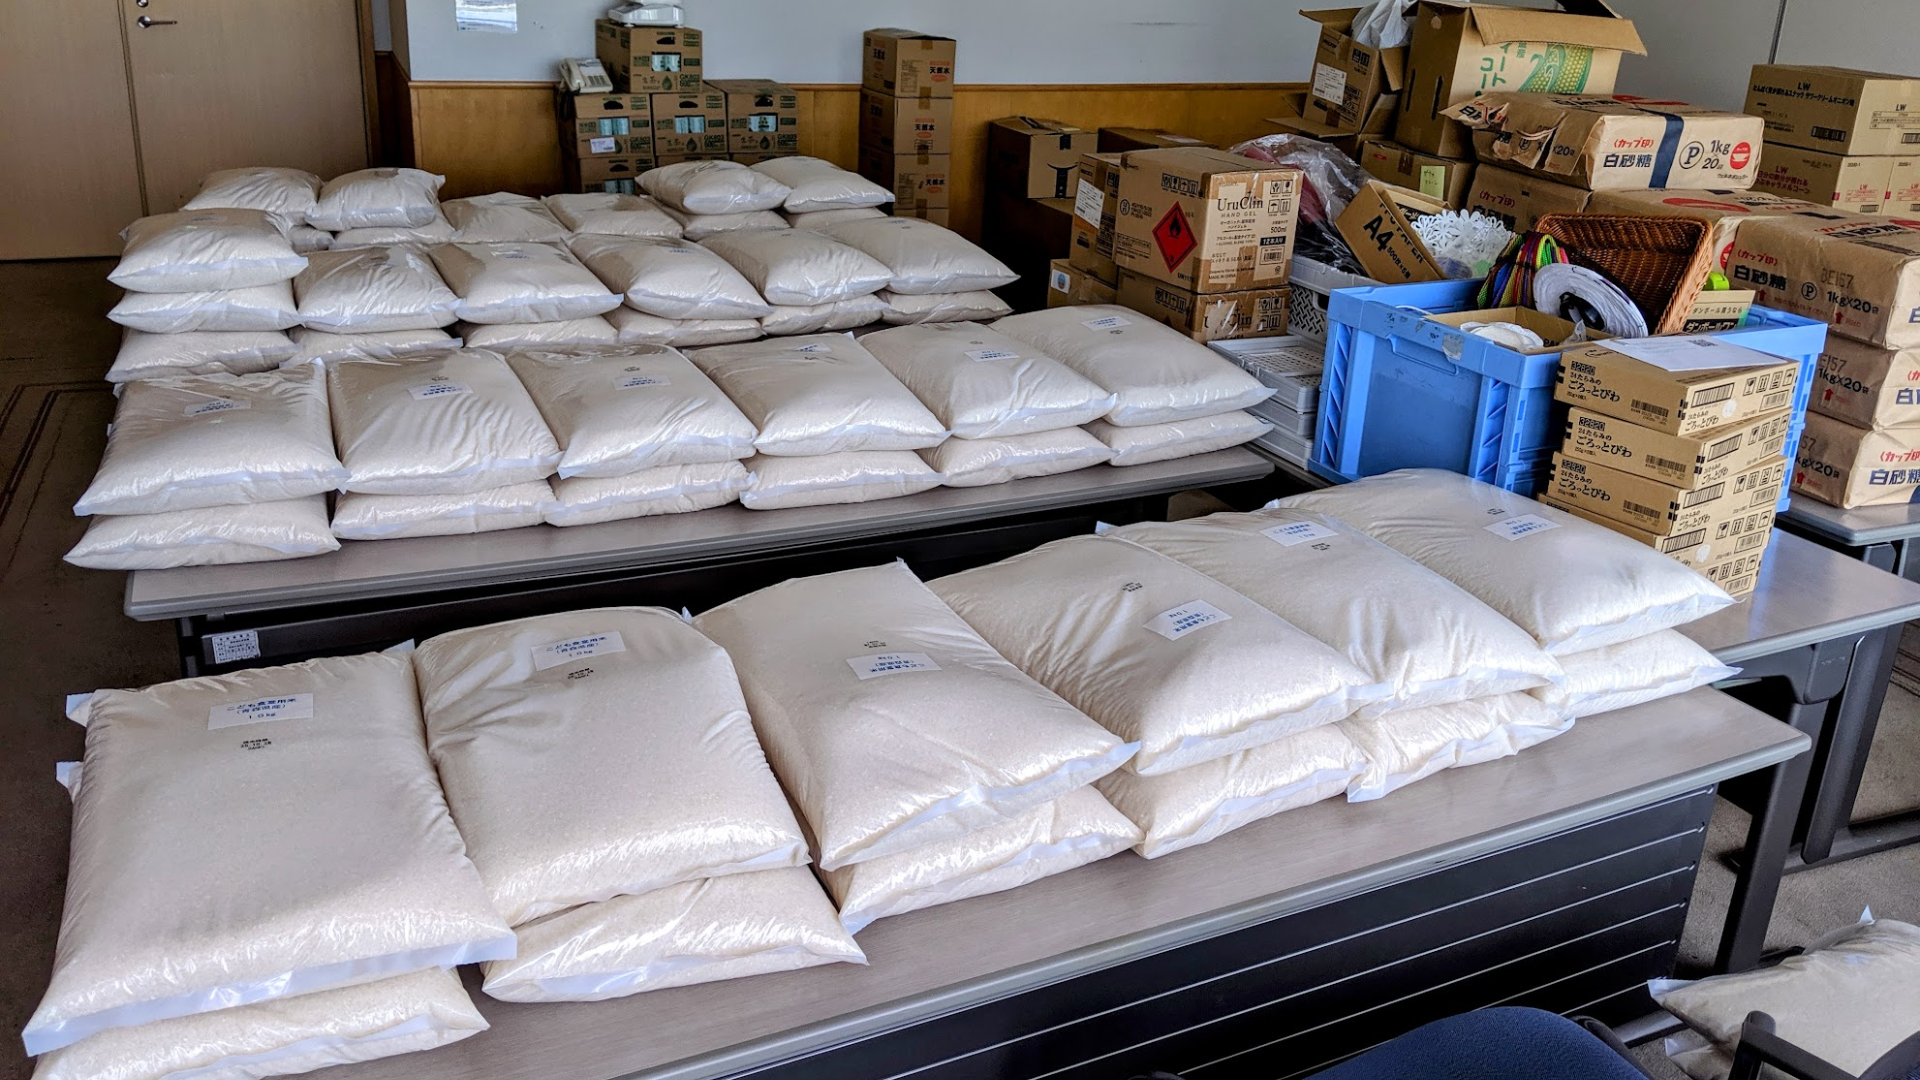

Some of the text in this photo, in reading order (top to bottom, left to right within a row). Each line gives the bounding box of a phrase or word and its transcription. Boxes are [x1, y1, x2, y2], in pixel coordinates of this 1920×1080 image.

[1797, 82, 1811, 91] LW
[1710, 139, 1731, 156] 1kg
[1603, 154, 1653, 168] 白砂糖
[1775, 166, 1788, 174] LW
[1217, 195, 1263, 212] UruClin
[1270, 226, 1287, 234] 500ml
[1363, 215, 1395, 252] A4
[1734, 265, 1787, 291] 白砂糖
[1567, 379, 1620, 402] ごろっとびわ
[1576, 435, 1633, 458] ごろっとびわ
[1558, 477, 1611, 501] ごろっとびわ
